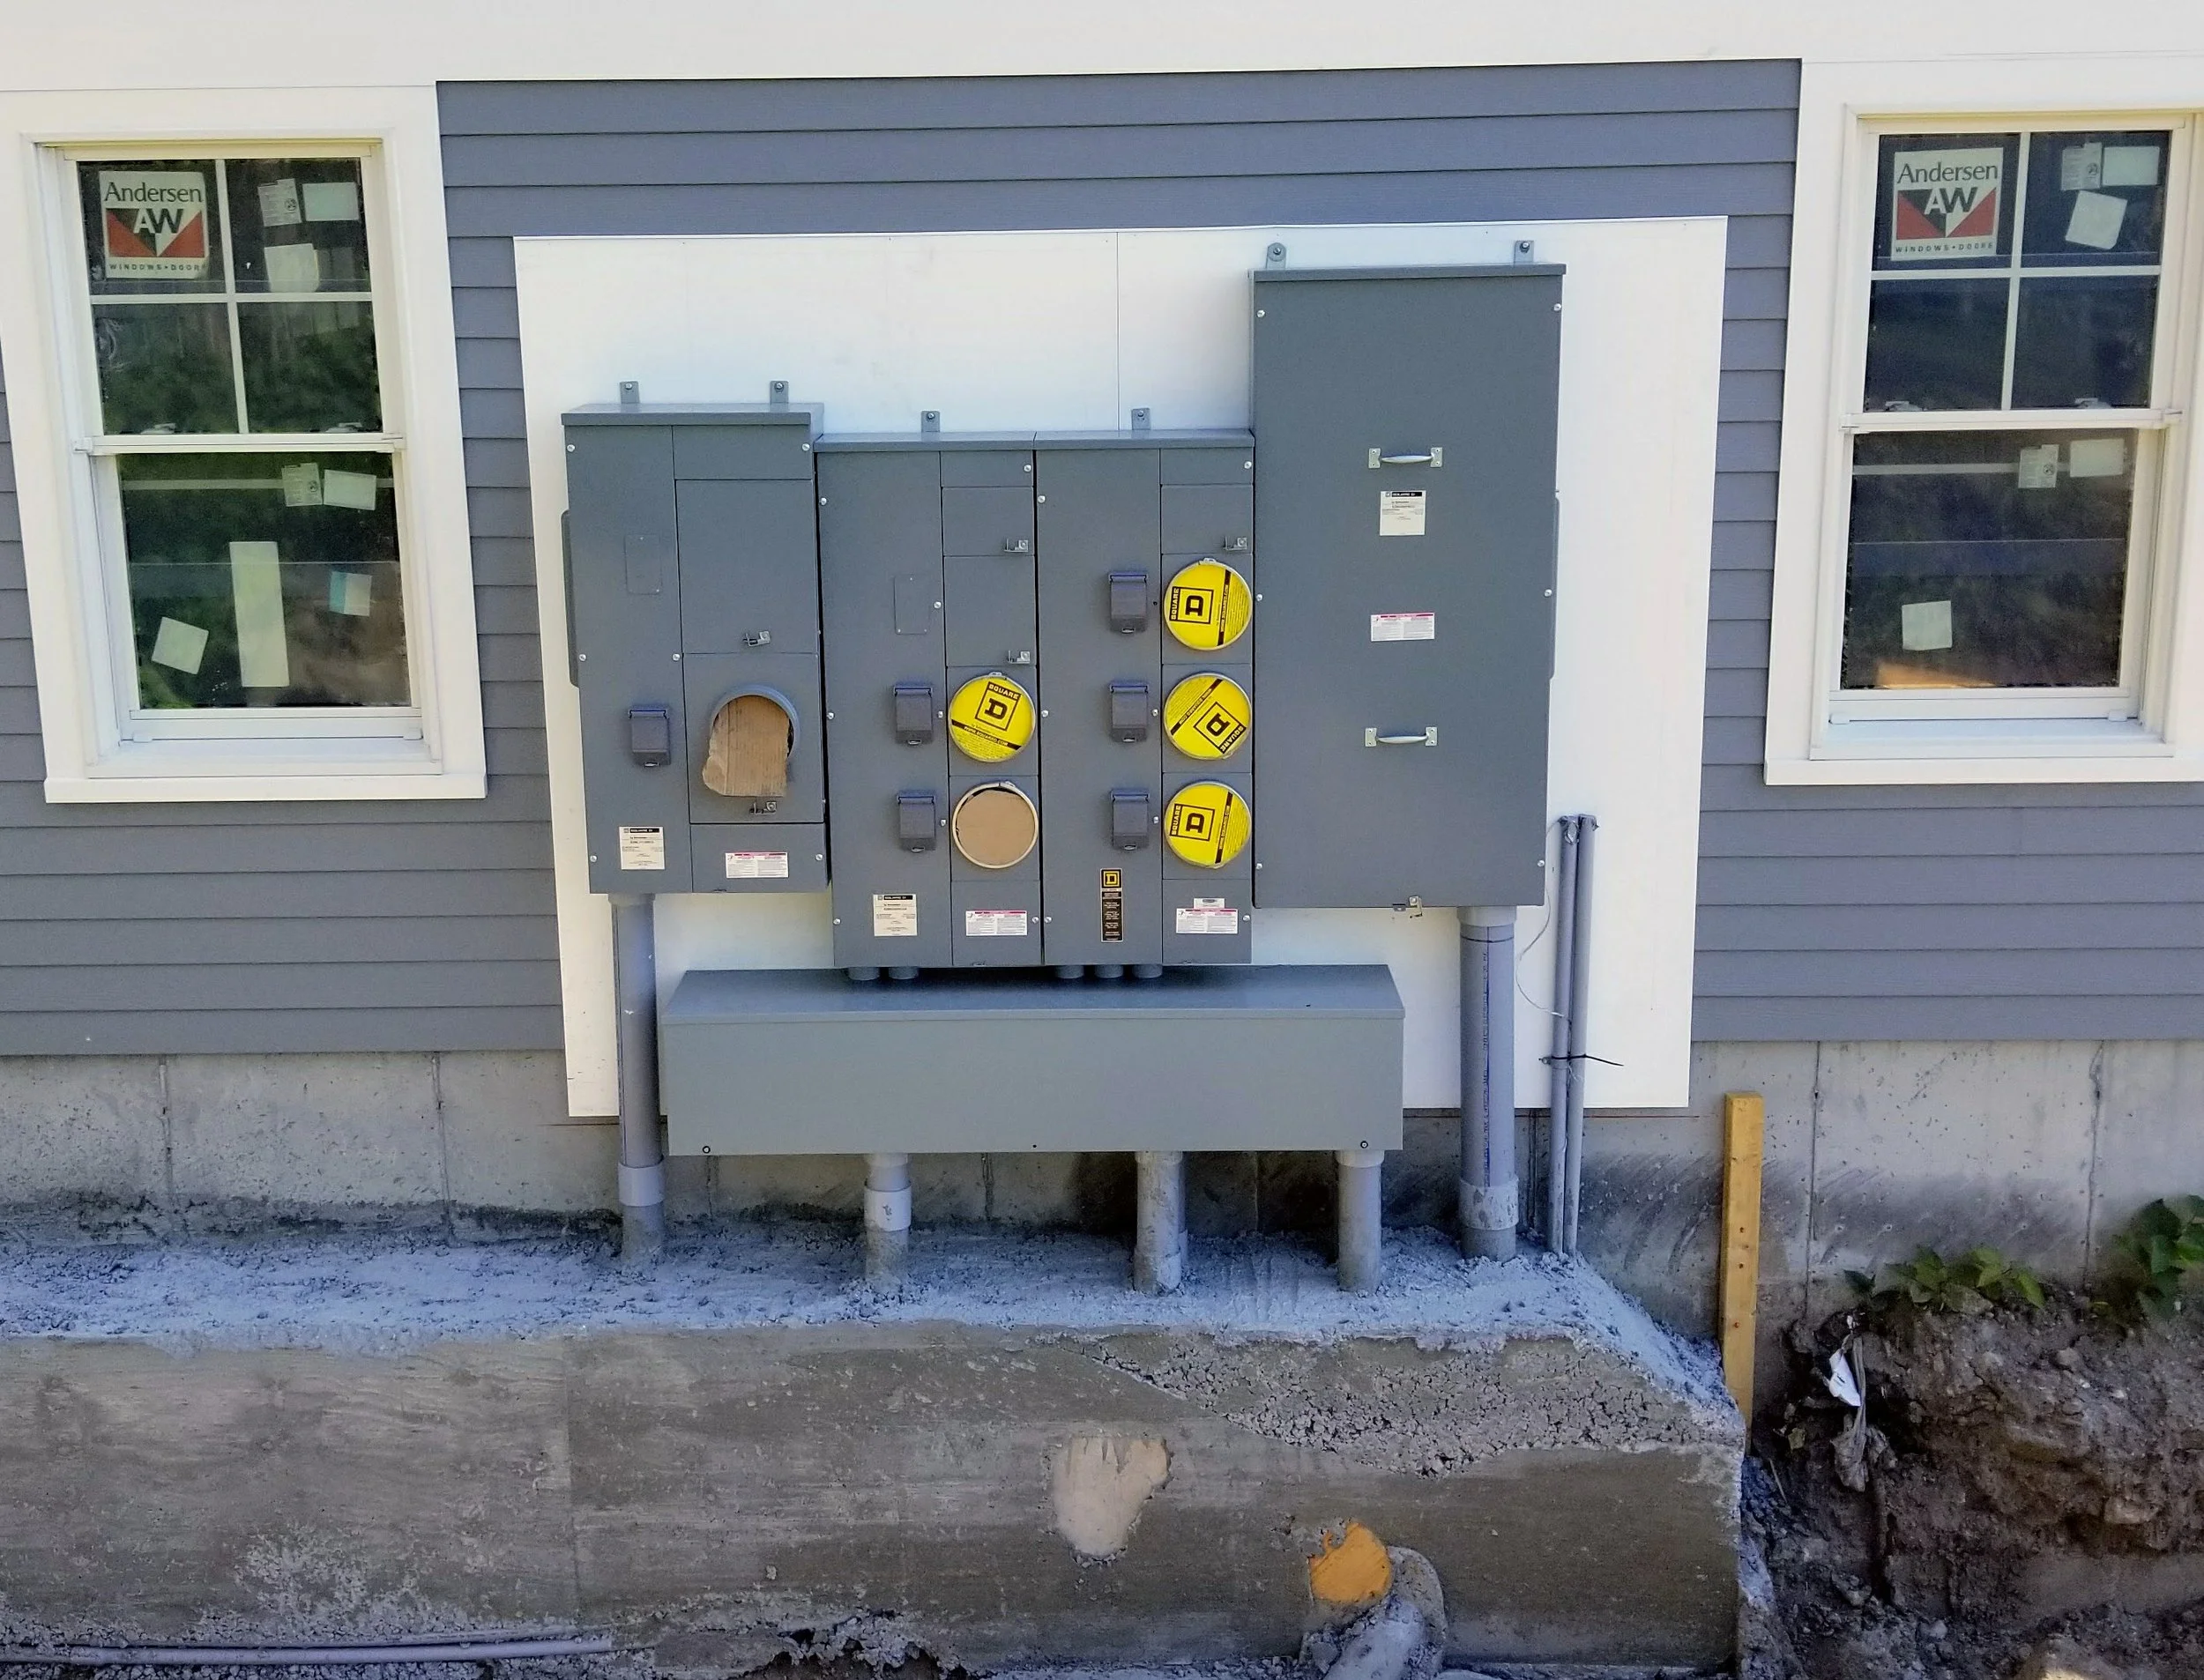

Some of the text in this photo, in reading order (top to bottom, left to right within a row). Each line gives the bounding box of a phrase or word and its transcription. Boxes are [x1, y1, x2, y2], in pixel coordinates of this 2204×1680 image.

[1896, 161, 1999, 184] Andersen
[104, 181, 205, 203] Andersen
[1924, 186, 1978, 215] AW
[133, 208, 184, 234] AW
[1171, 587, 1180, 621] SQUARE
[1185, 594, 1204, 617] D
[988, 683, 1019, 700] SQUARE
[984, 697, 1008, 719] D
[1206, 712, 1231, 737] D
[1220, 725, 1244, 752] SQUARE
[1171, 805, 1181, 836] SQUARE
[1186, 812, 1205, 834] D
[1106, 873, 1117, 885] D
